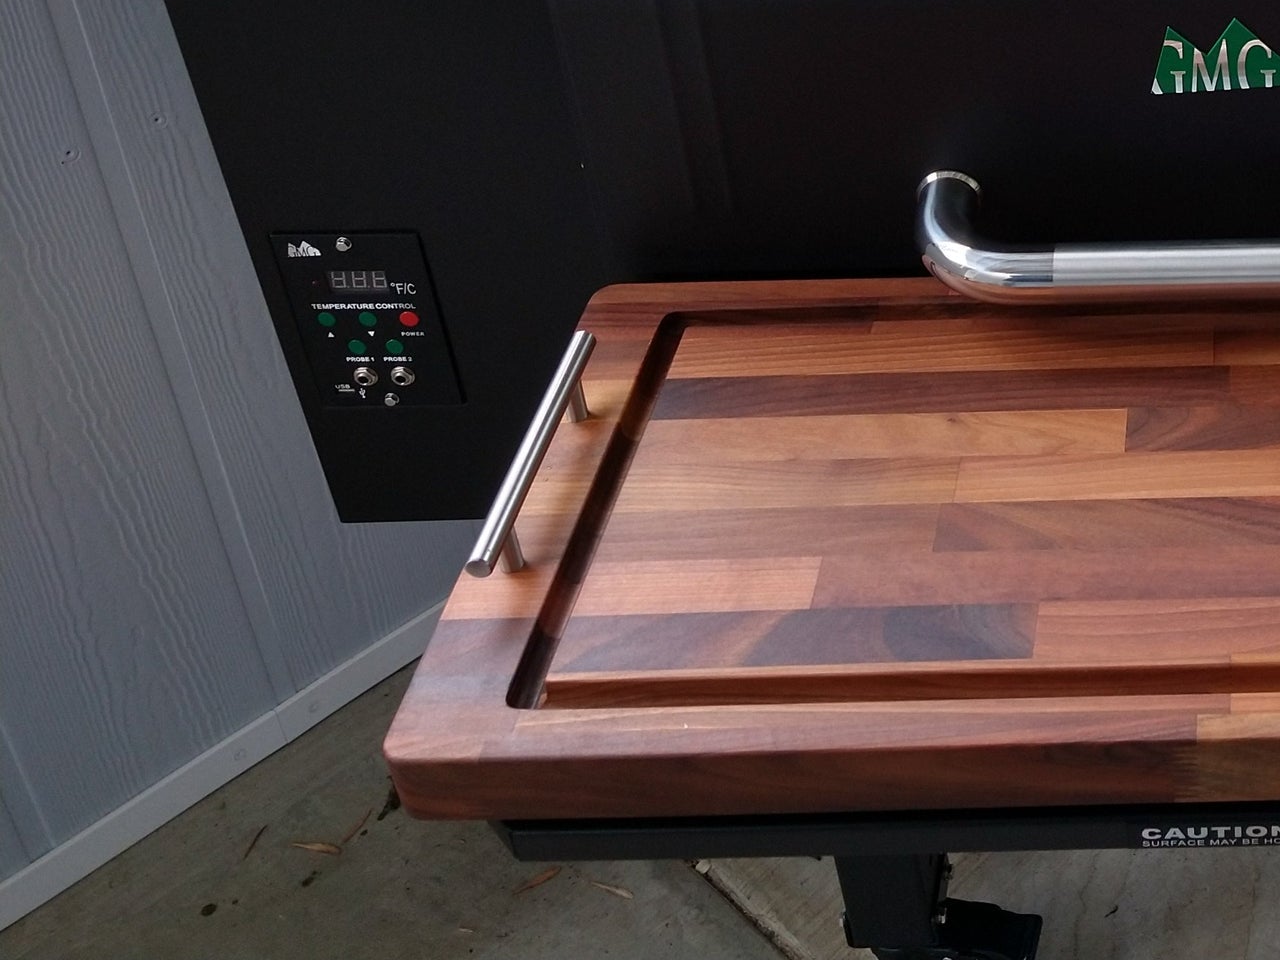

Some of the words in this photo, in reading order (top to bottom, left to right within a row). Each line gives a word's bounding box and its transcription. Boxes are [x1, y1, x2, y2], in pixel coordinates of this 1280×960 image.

[1151, 37, 1278, 95] GMG
[1142, 839, 1205, 848] SURFACE
[1210, 838, 1238, 846] MAY
